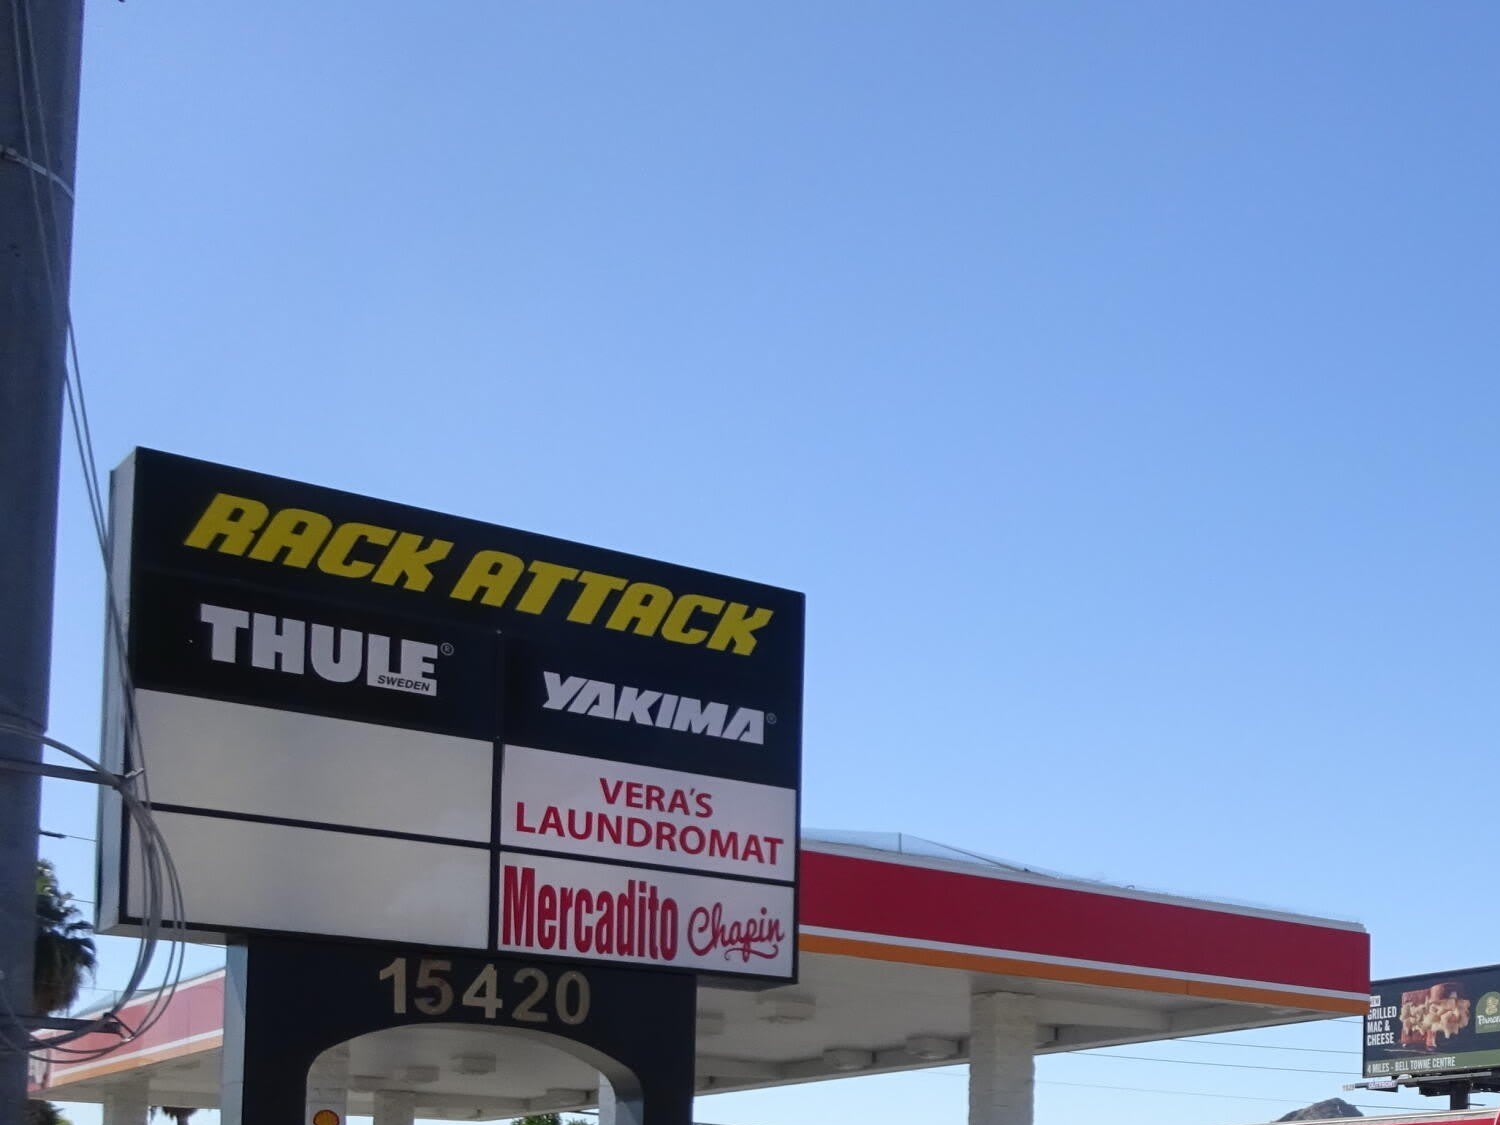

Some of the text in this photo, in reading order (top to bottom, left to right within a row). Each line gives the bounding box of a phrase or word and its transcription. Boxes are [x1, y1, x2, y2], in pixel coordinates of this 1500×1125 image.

[183, 492, 775, 657] RACK ATTACK
[200, 602, 439, 697] THULE
[377, 674, 431, 692] SWEDEN
[542, 670, 765, 746] YAKIMA
[600, 777, 714, 819] VERA'S
[515, 801, 785, 866] LAUNDROMAT
[501, 864, 786, 963] Mercadito Chapin
[378, 956, 592, 1026] 15420
[1367, 1006, 1397, 1021] GRILLED
[1367, 1019, 1391, 1034] MAC &
[1367, 1032, 1395, 1047] CHEESE
[1372, 1063, 1390, 1074] MILES
[1395, 1060, 1410, 1072] BELL
[1410, 1059, 1431, 1071] TOWNE
[1432, 1056, 1456, 1069] CENTRE
